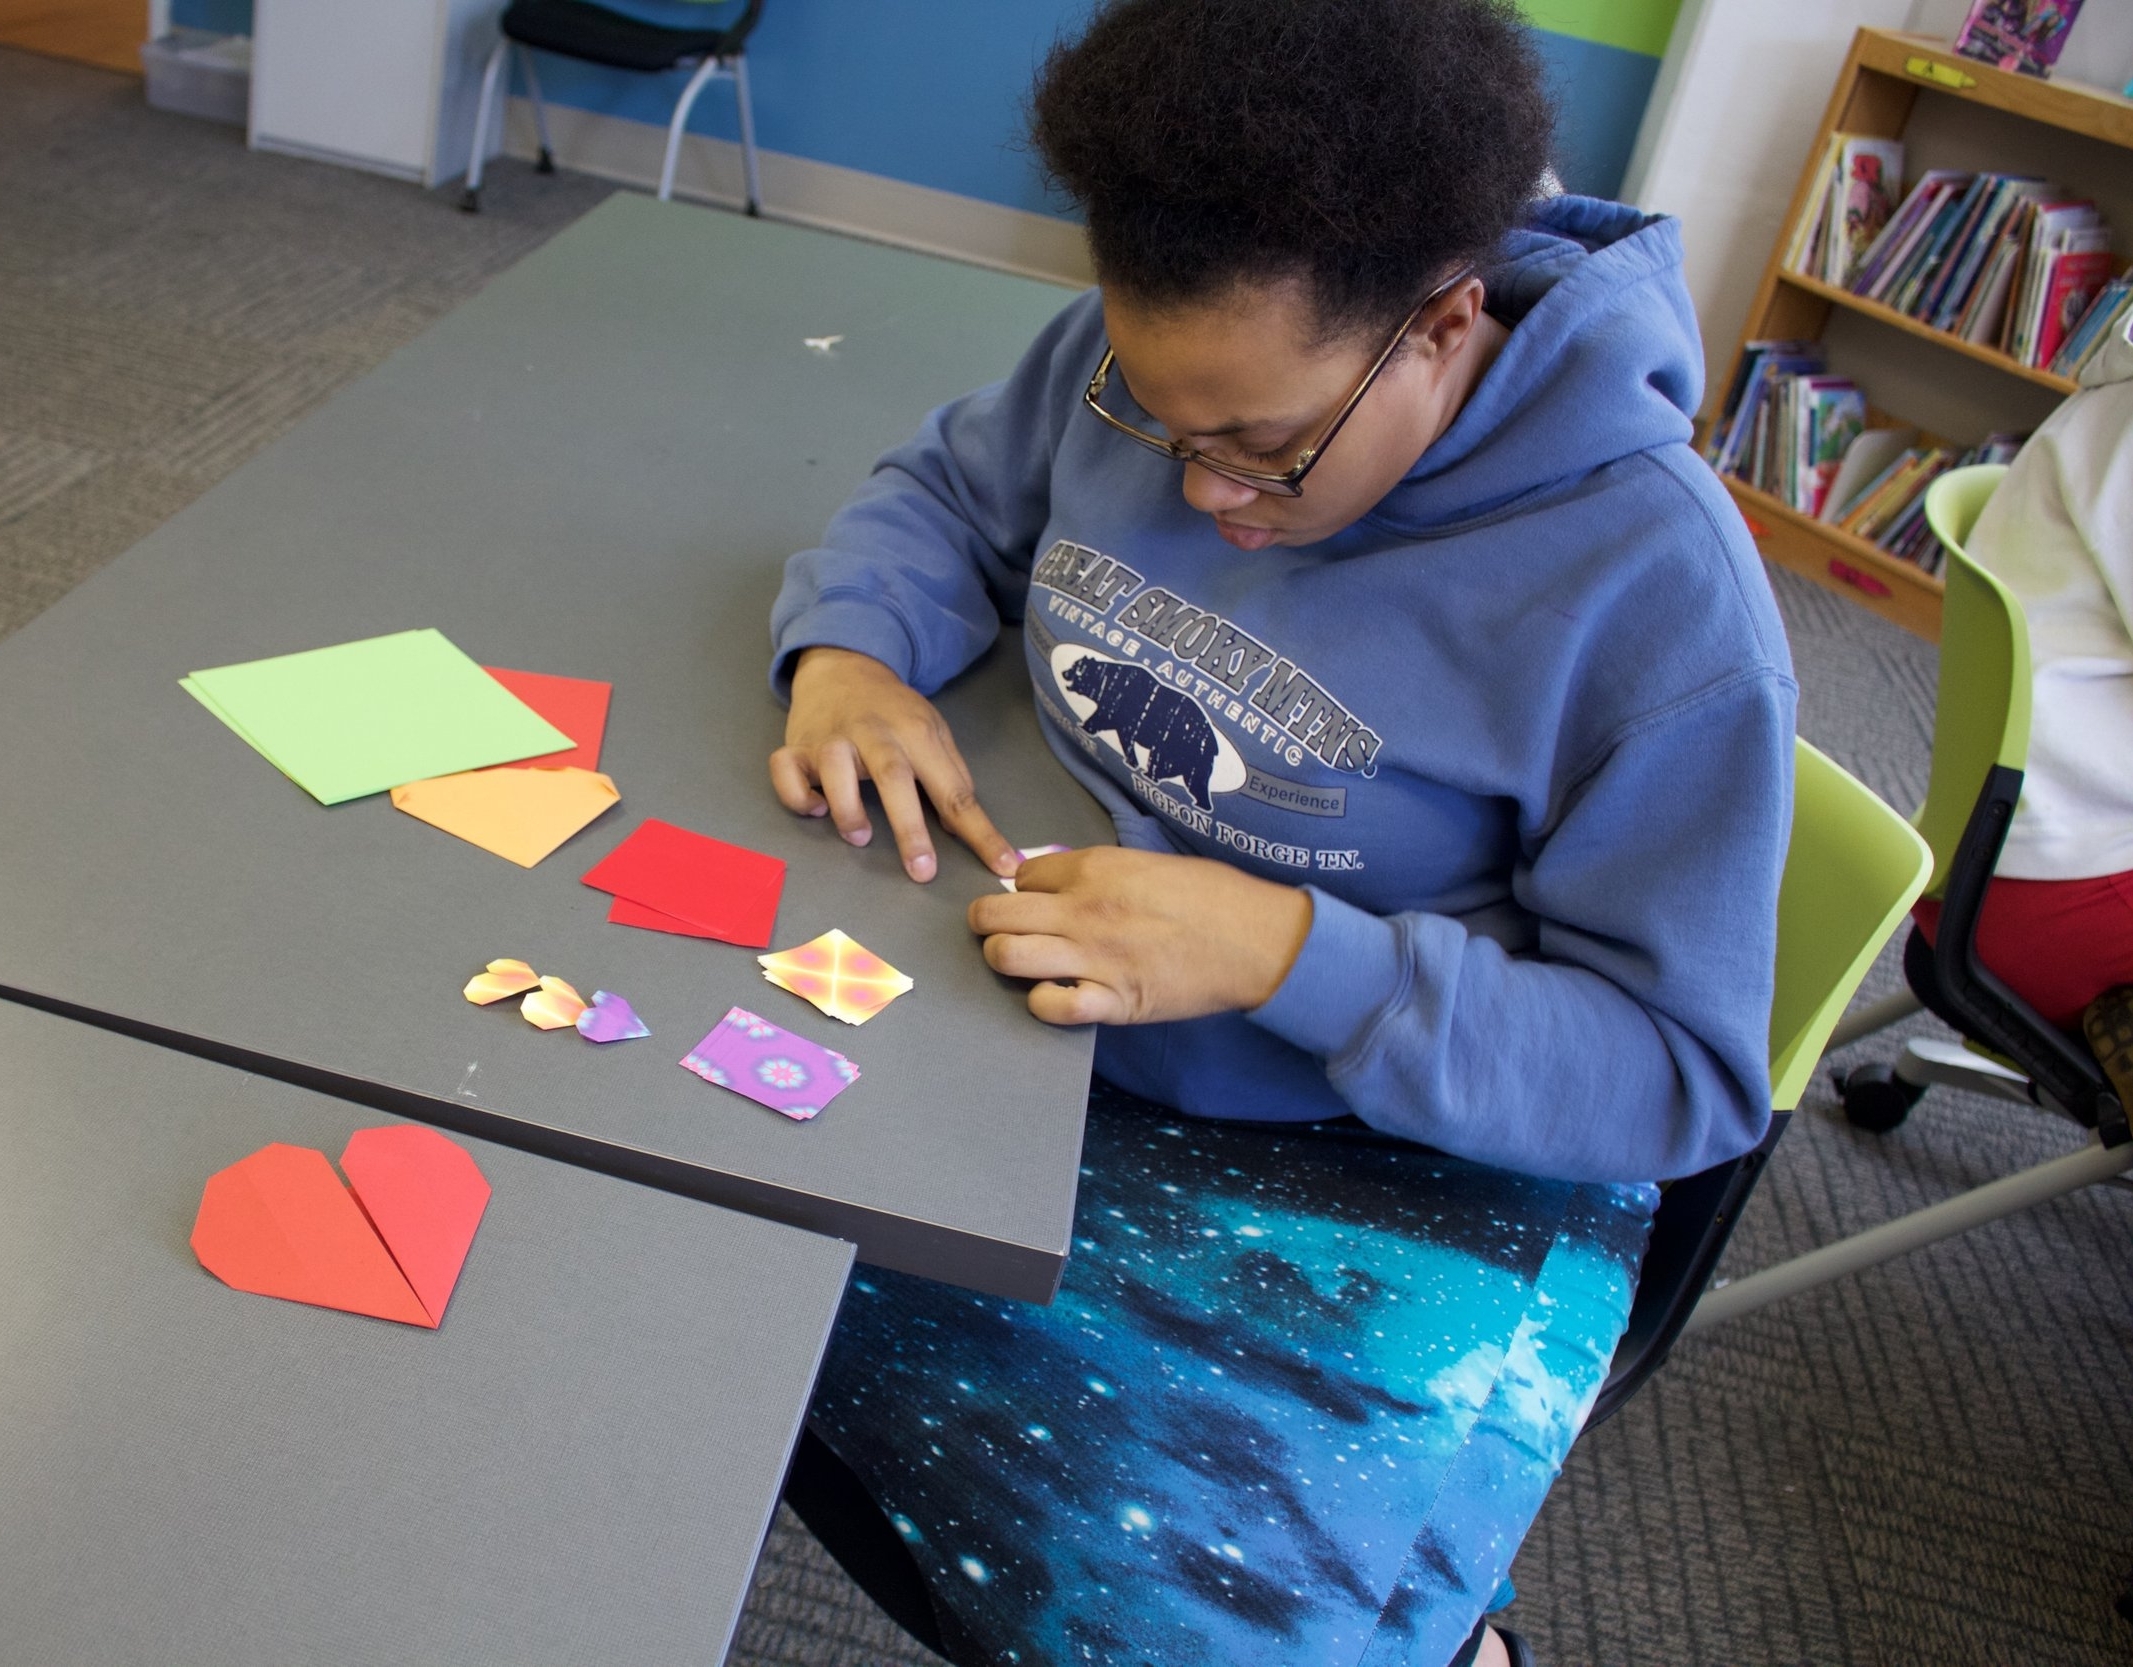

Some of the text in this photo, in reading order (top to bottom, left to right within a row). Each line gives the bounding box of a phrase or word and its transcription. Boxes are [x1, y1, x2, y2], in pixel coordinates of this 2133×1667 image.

[1048, 594, 1141, 657] VINTAGE
[1156, 661, 1303, 767] AUTHENTIC
[1114, 587, 1277, 696] SMOKY
[1131, 773, 1364, 870] PIGEON FORGE TN.
[1249, 776, 1340, 810] Experience
